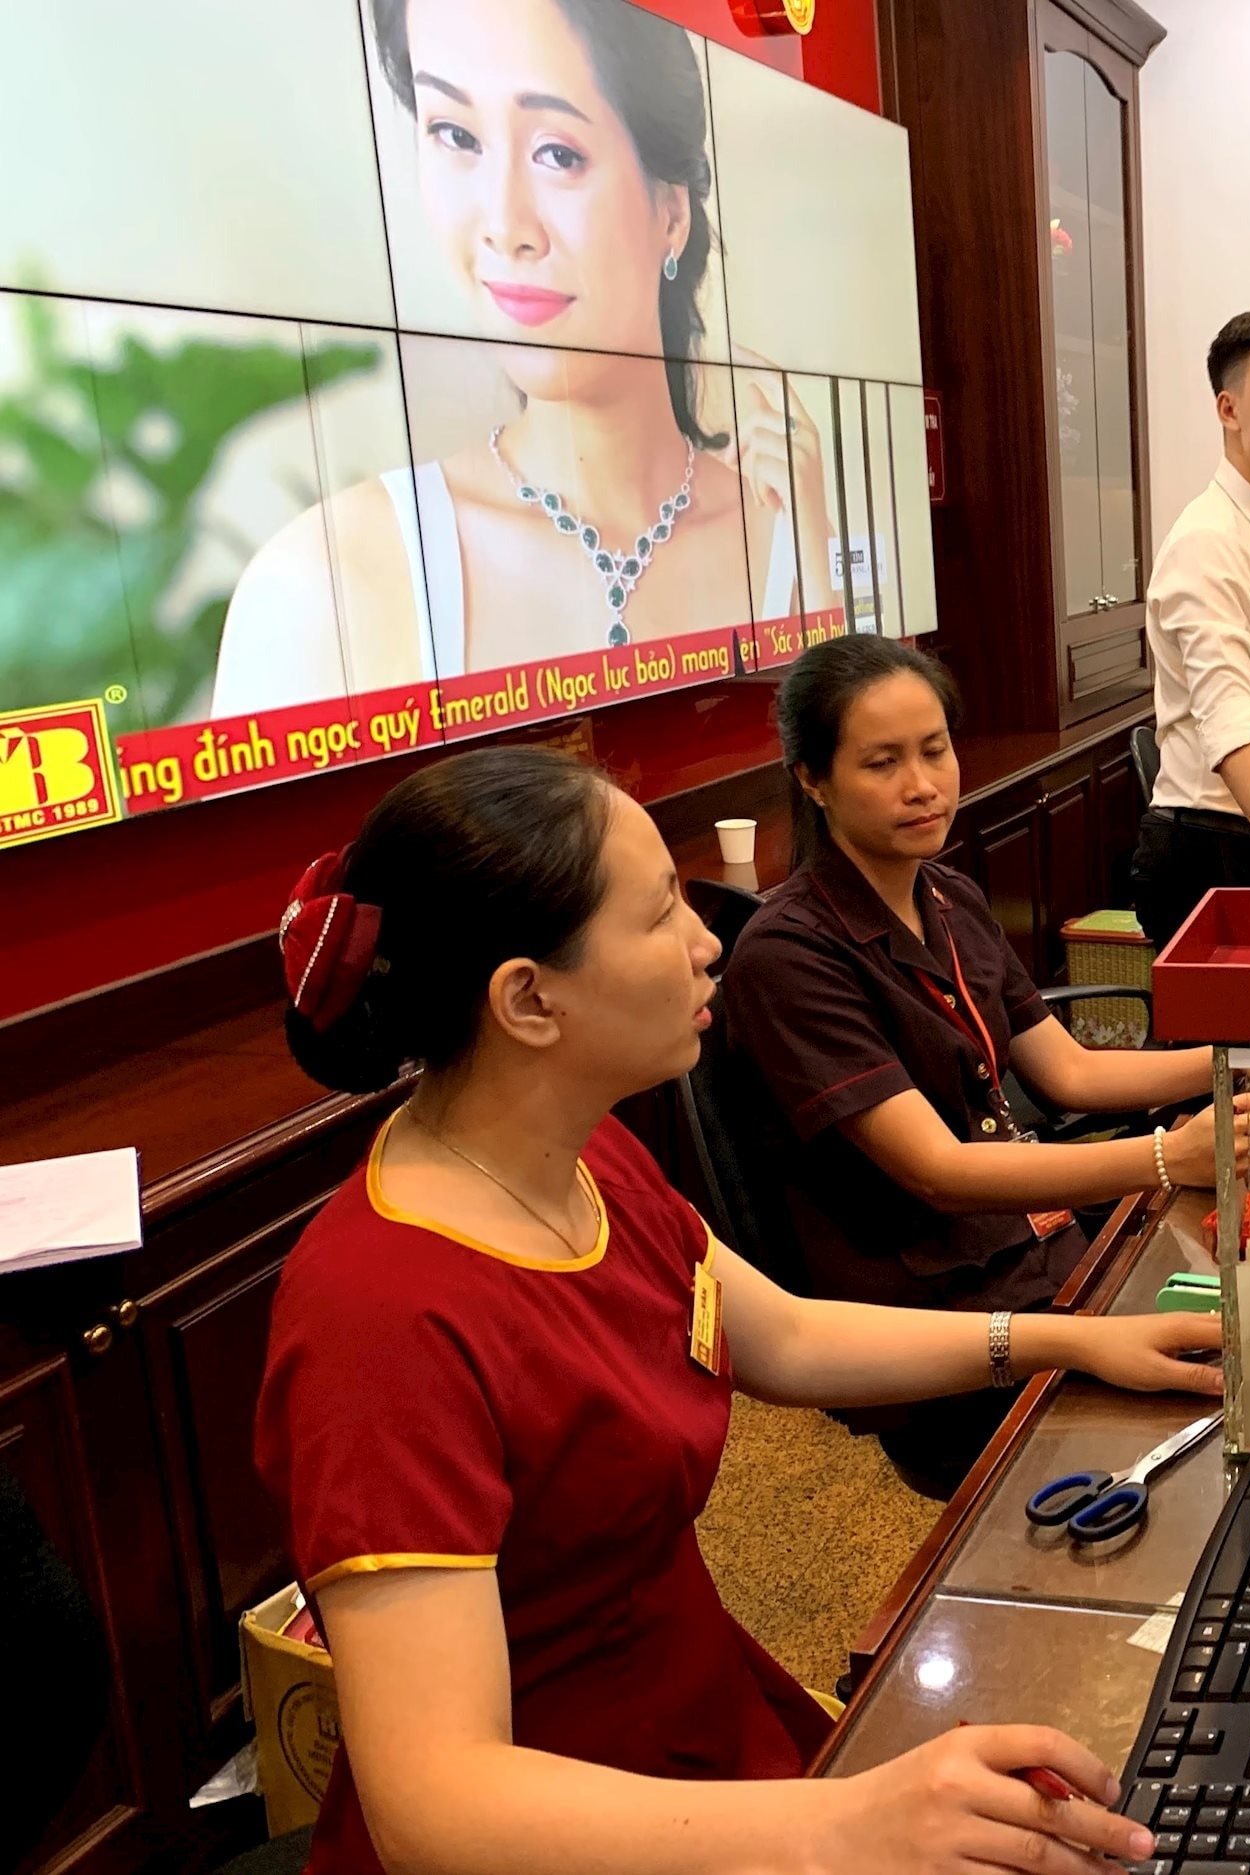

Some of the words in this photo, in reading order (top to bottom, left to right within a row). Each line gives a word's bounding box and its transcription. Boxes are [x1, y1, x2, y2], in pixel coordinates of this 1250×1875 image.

[194, 719, 276, 781] đính
[286, 720, 362, 769] ngọc
[369, 697, 421, 751] quý
[429, 669, 529, 731] Emerald
[536, 667, 598, 710] (Ngọc
[602, 654, 630, 695] lục
[634, 644, 676, 685] bảo)
[682, 646, 729, 680] mang
[0, 808, 46, 833] TMC
[51, 797, 100, 821] 1989
